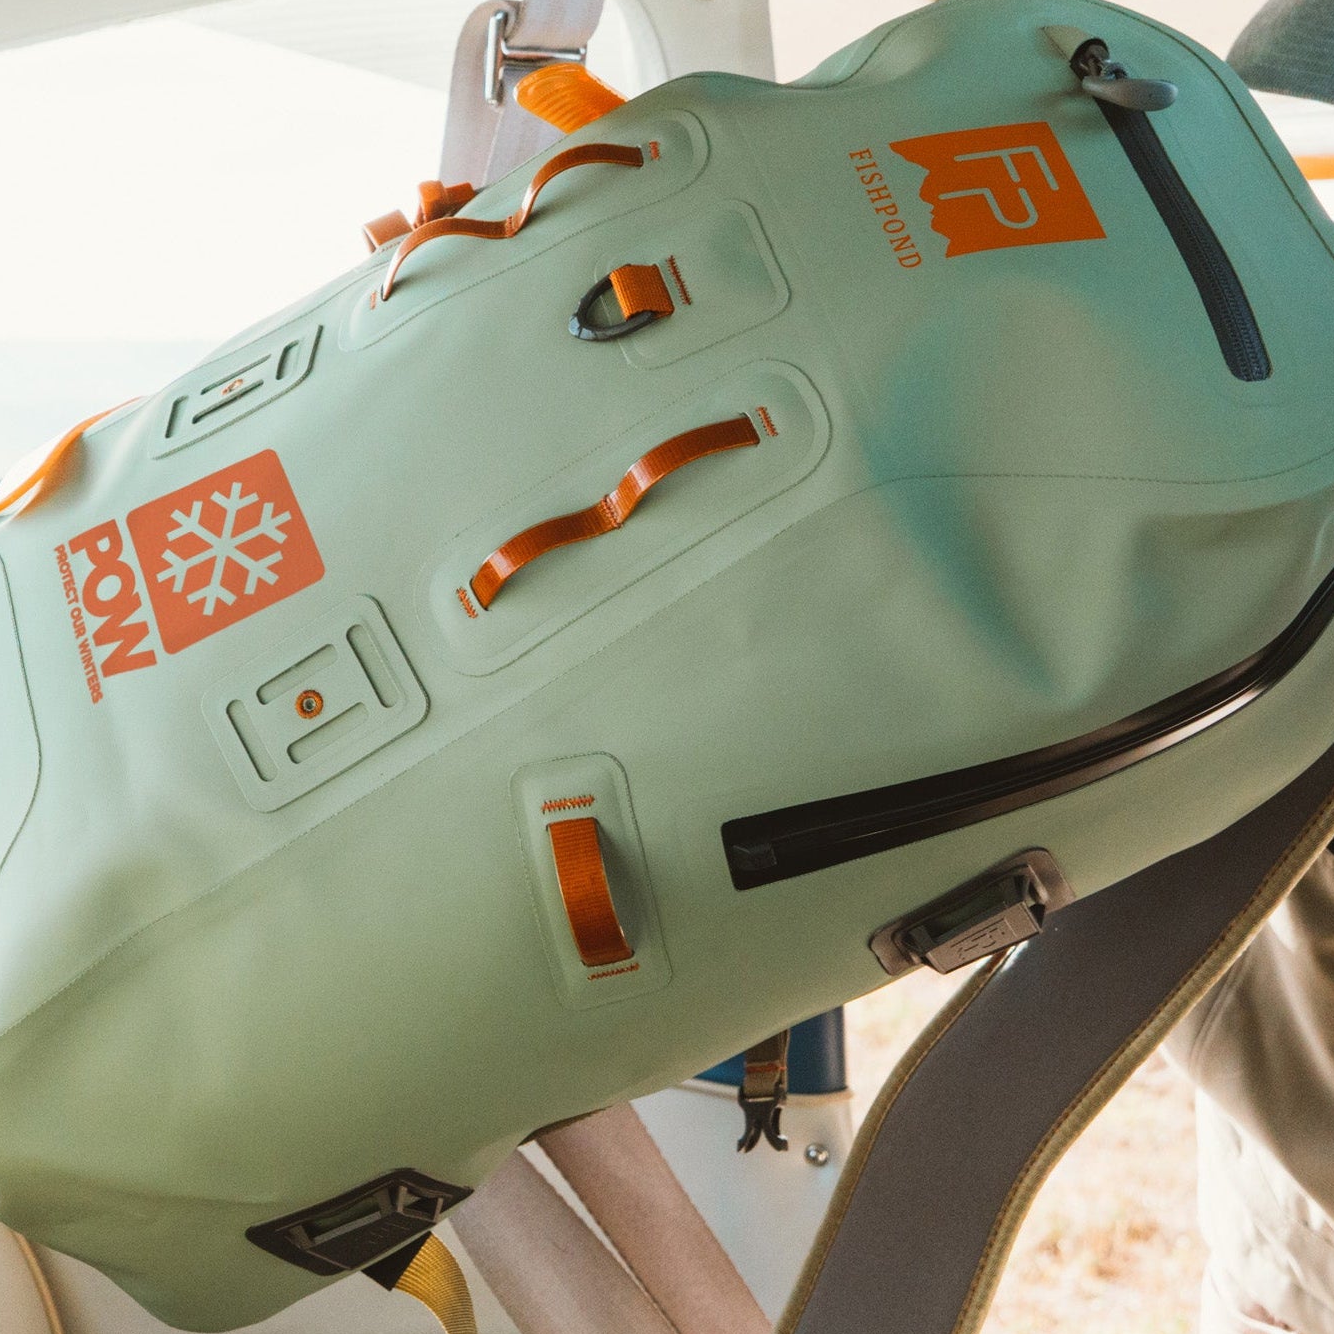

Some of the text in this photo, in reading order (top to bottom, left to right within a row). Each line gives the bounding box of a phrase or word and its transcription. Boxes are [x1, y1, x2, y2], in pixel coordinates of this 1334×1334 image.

[849, 148, 922, 269] FISHPOND
[54, 544, 103, 704] PROTECT OUR WINTERS
[68, 519, 157, 678] POW
